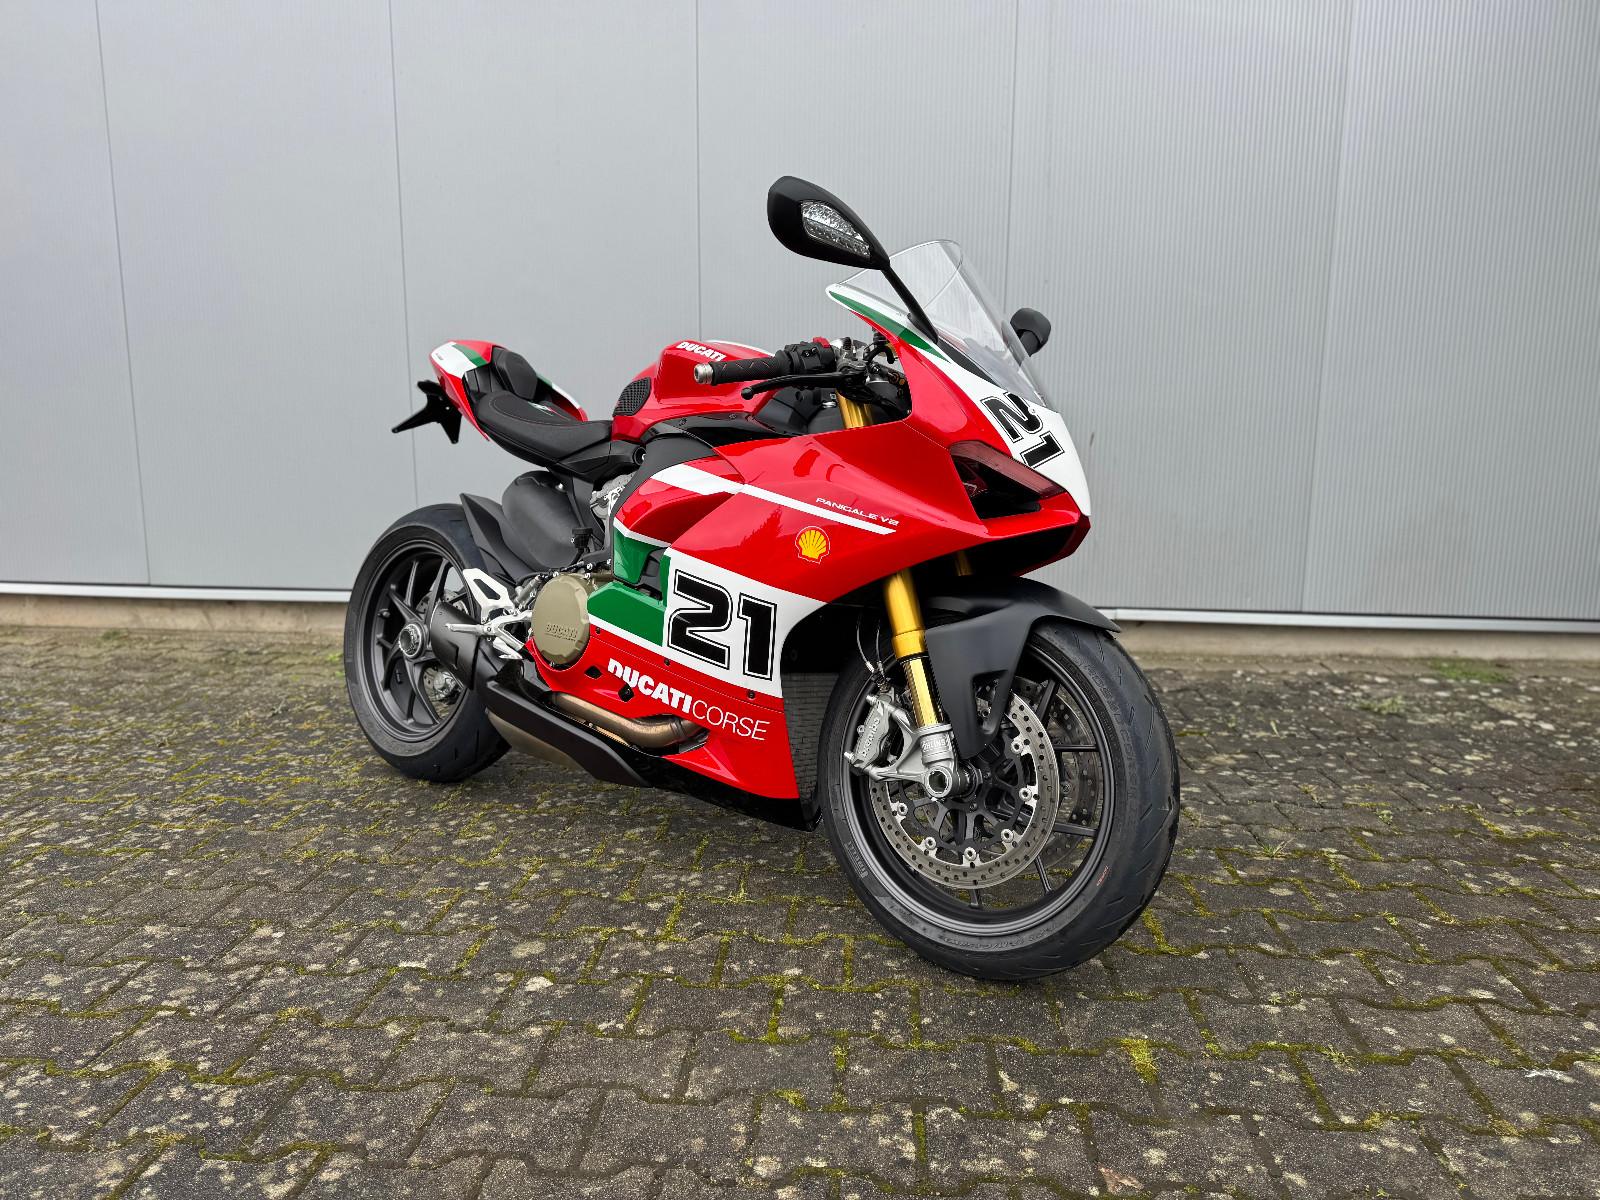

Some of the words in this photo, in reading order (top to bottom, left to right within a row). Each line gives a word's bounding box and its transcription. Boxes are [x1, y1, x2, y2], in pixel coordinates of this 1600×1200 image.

[676, 341, 727, 362] DUCATI
[980, 391, 1065, 469] 21
[815, 497, 879, 520] PANIGALE
[880, 515, 900, 527] V2
[667, 569, 778, 682] 21
[692, 700, 771, 741] CORSE
